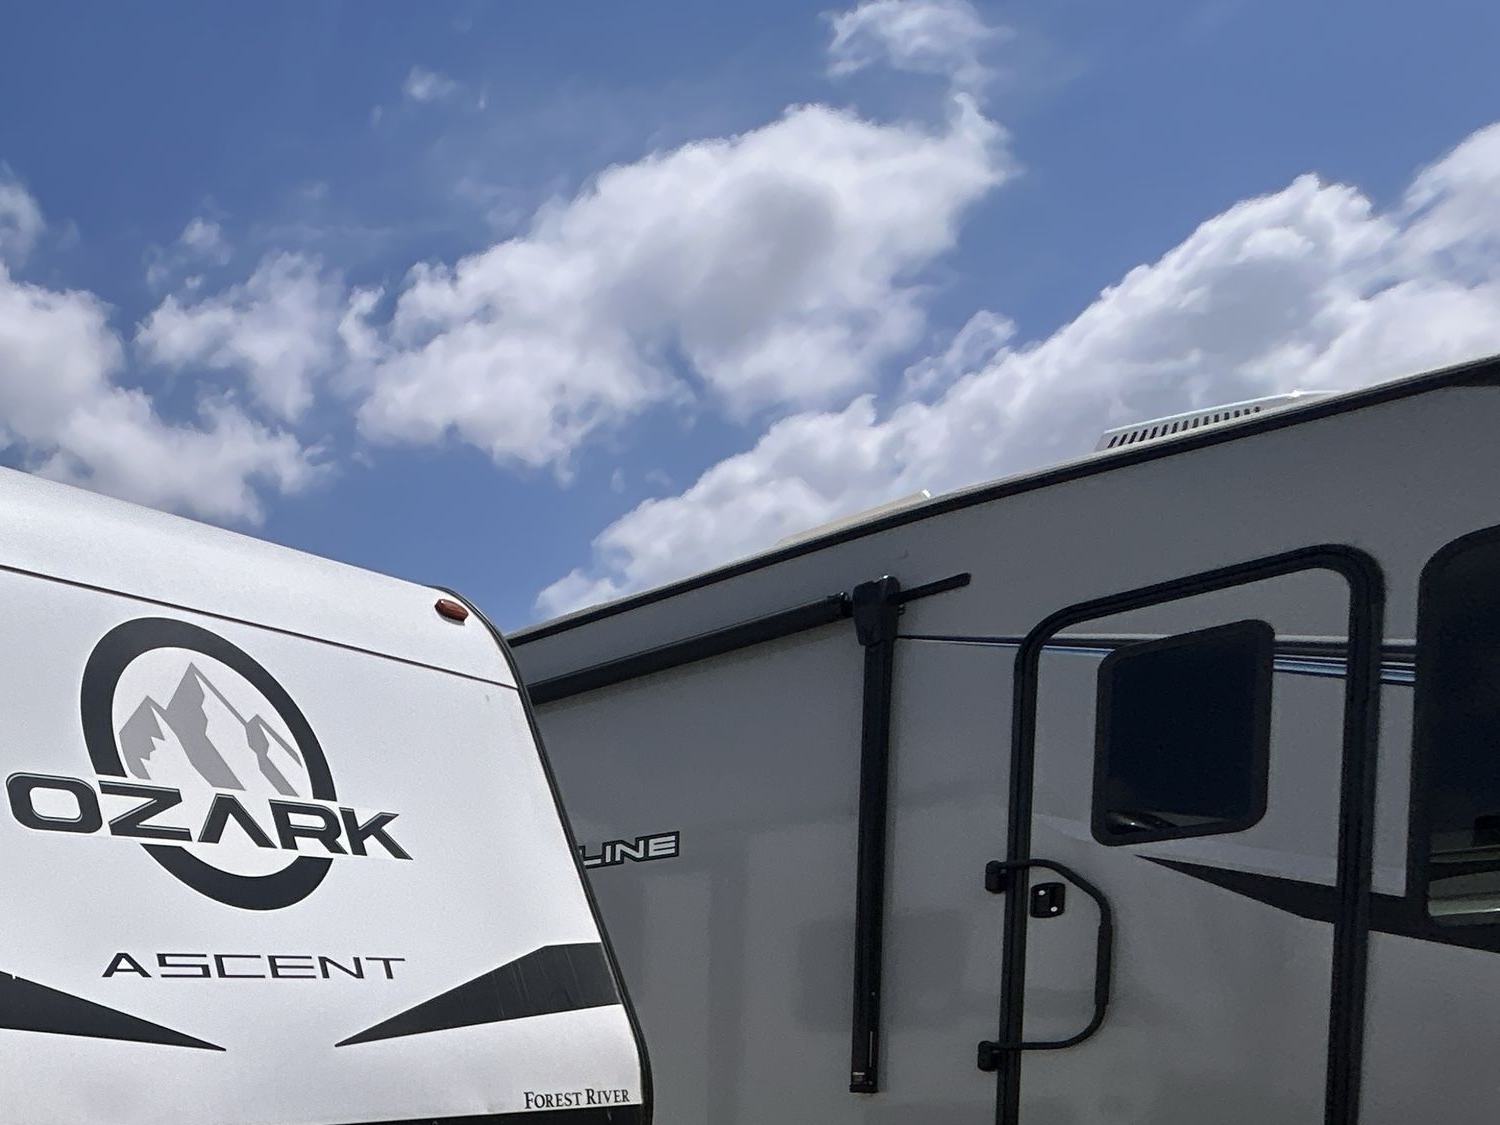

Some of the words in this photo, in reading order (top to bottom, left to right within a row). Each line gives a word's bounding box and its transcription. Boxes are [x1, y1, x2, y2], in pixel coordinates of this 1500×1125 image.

[6, 771, 413, 860] OZARK
[102, 952, 406, 980] ASCENT
[523, 1091, 583, 1109] FOREST
[585, 1088, 630, 1105] RIVER
